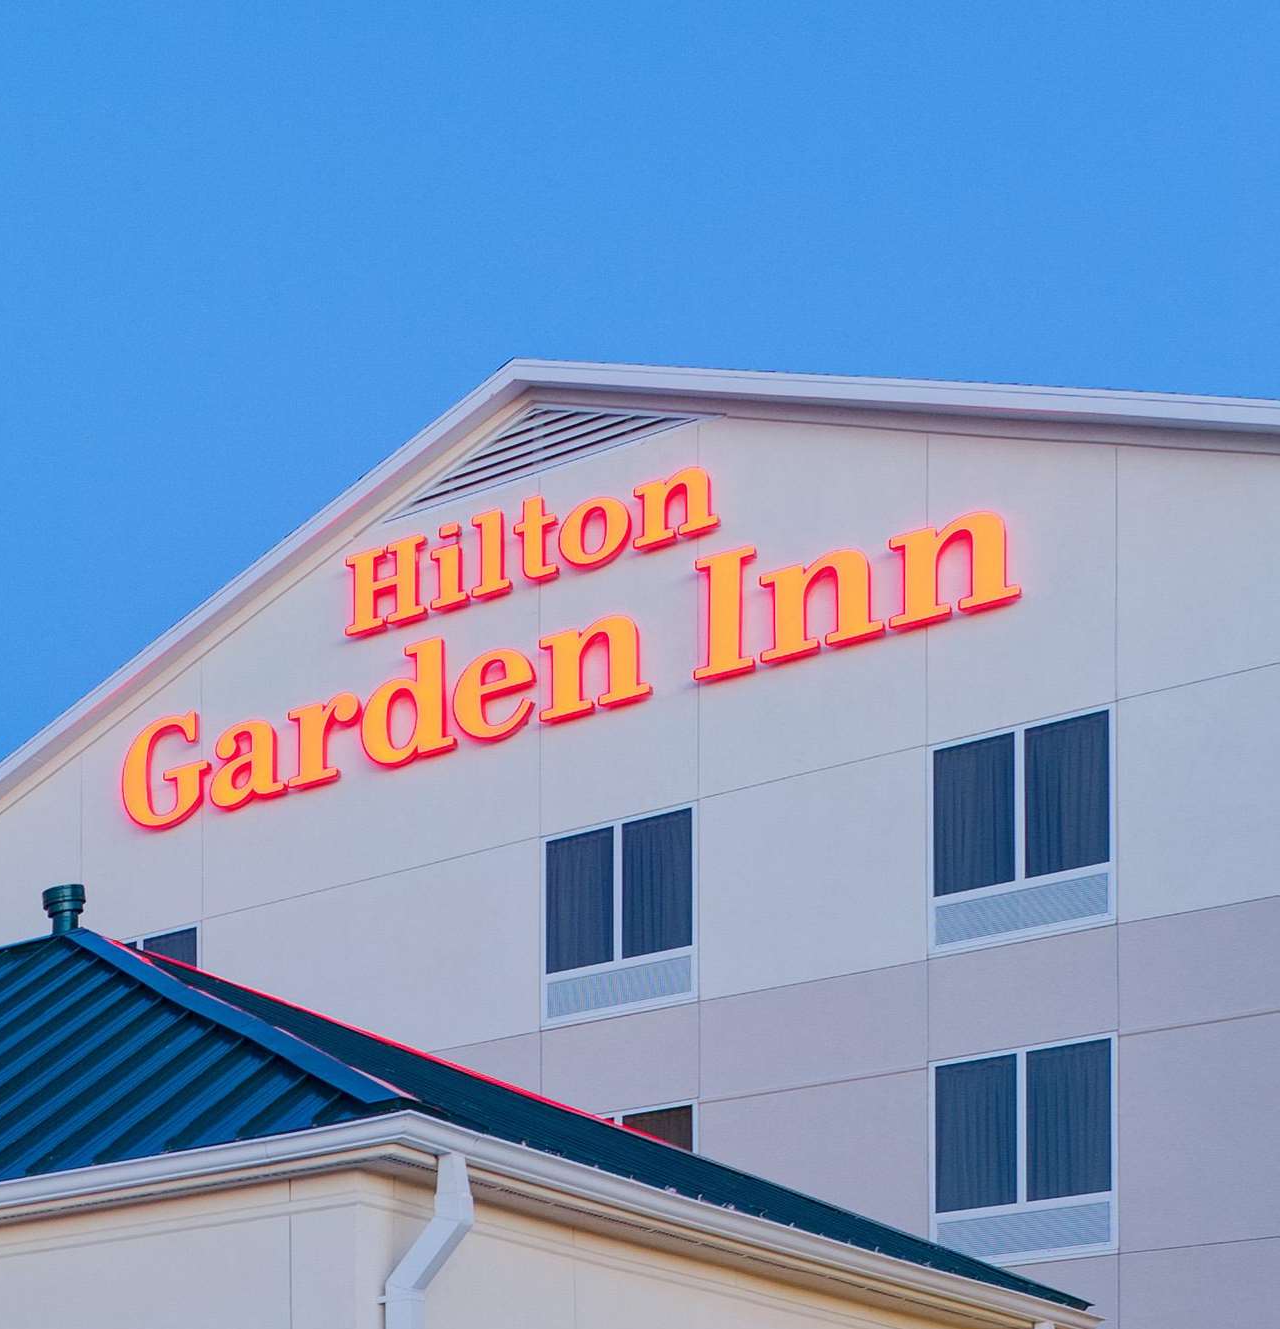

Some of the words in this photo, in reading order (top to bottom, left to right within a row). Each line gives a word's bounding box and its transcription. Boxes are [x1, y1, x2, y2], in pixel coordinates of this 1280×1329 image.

[120, 613, 653, 831] Garden
[691, 509, 1022, 682] Inn
[345, 465, 720, 638] Hilton
